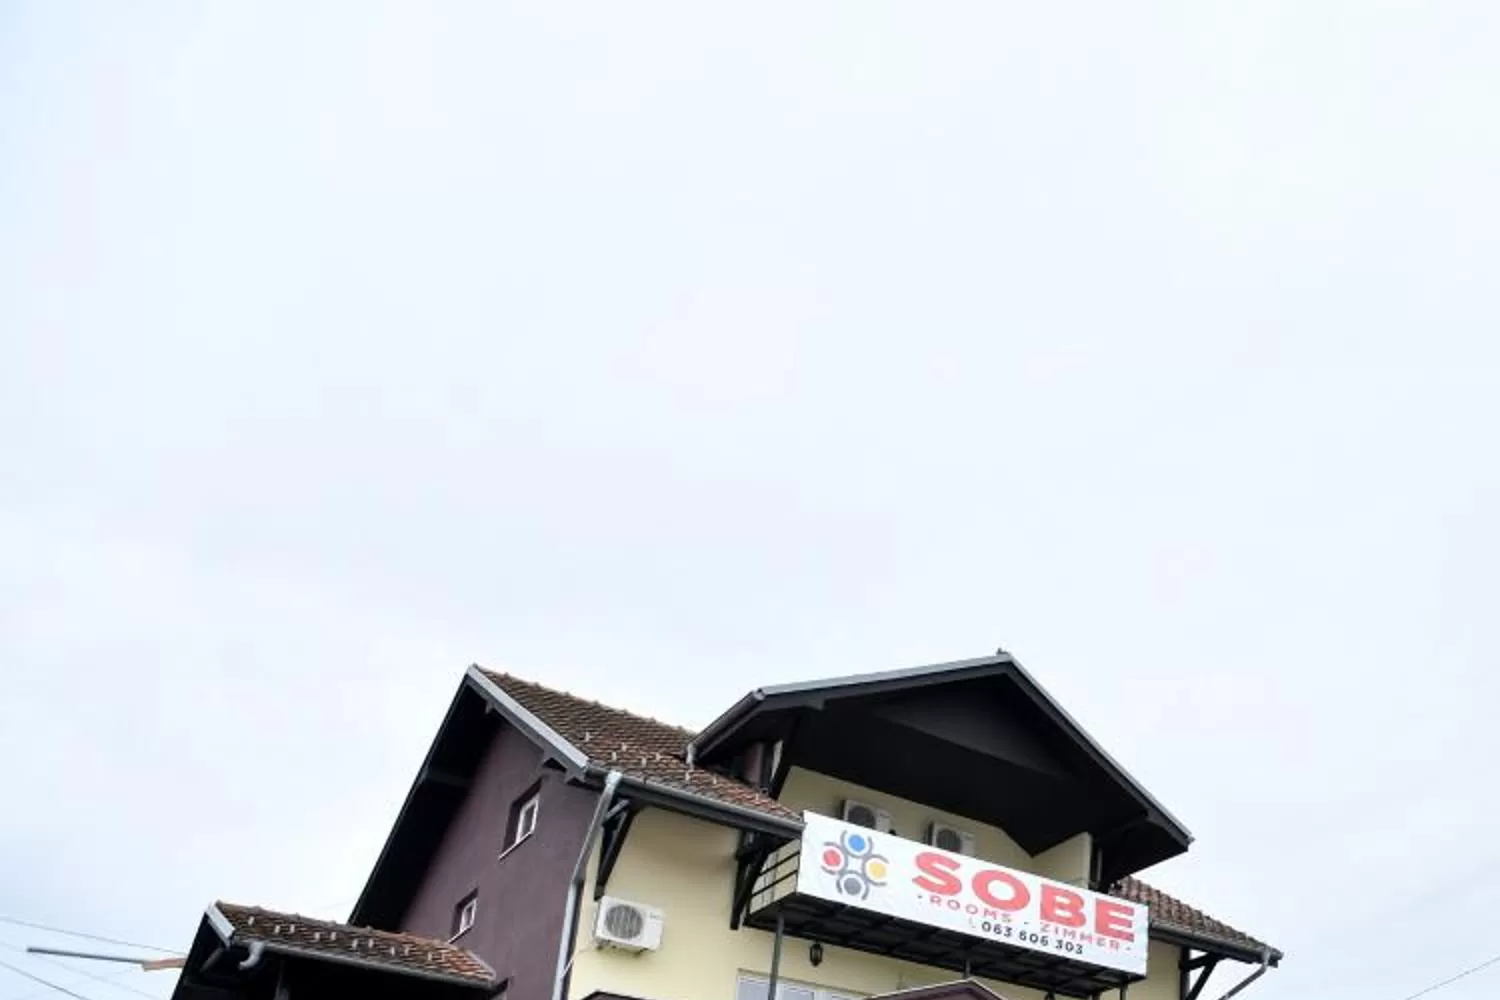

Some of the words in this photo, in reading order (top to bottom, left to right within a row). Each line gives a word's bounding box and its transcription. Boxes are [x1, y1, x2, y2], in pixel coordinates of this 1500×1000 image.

[912, 851, 1135, 943] SOBE
[929, 893, 1013, 924] ROOMS
[1040, 922, 1121, 953] ZIMMER
[981, 921, 1012, 939] 063
[1018, 931, 1049, 948] 606
[1055, 938, 1084, 956] 303
